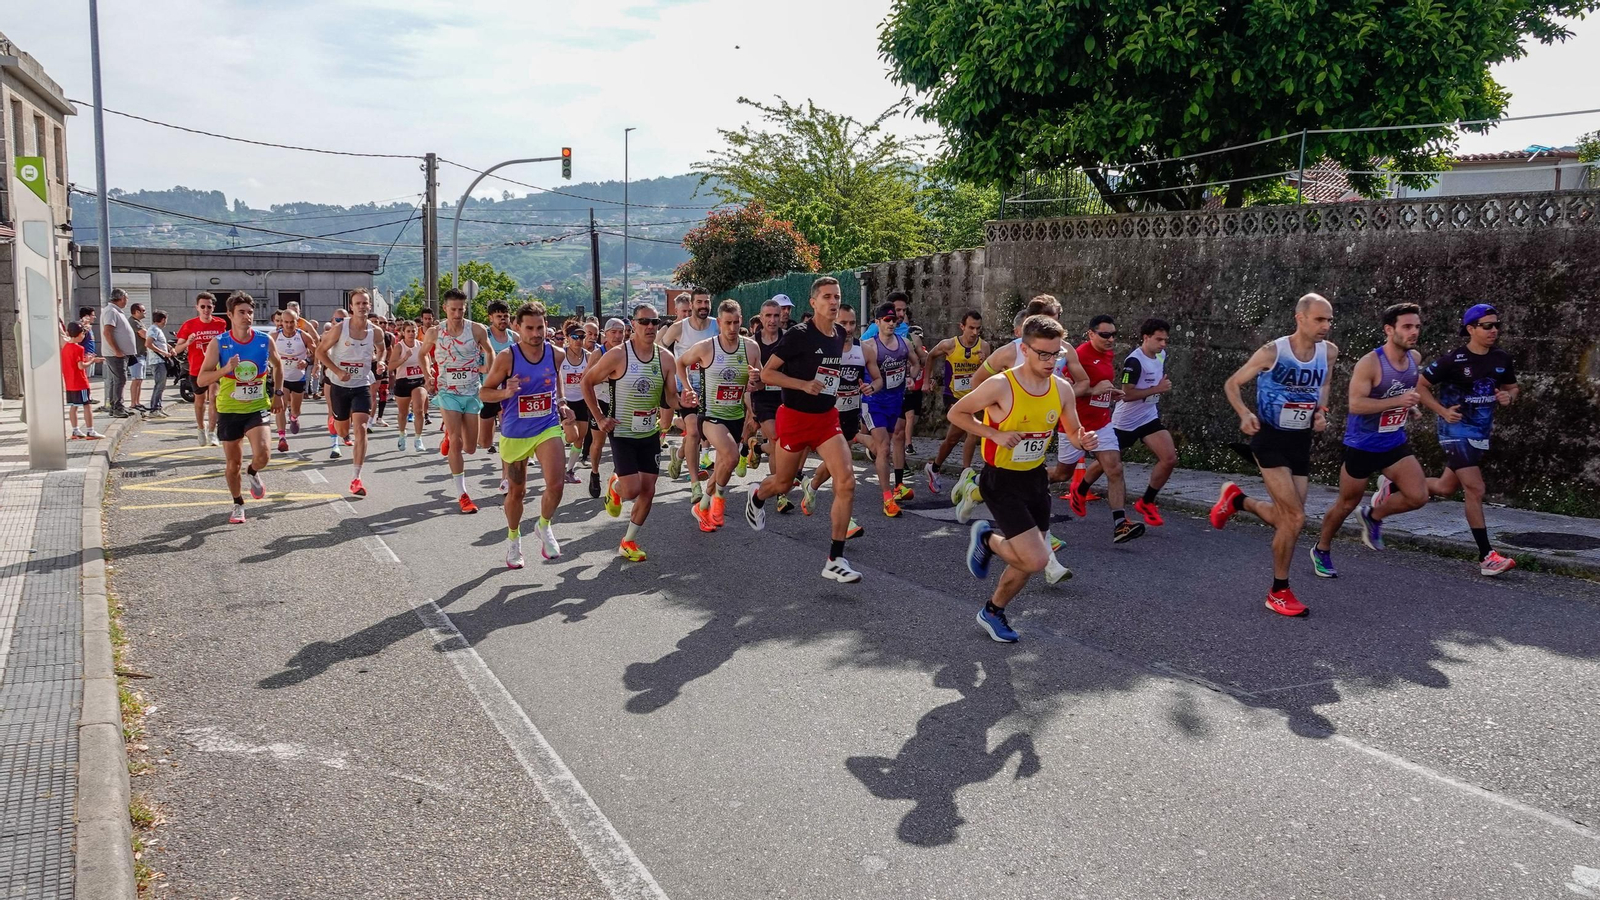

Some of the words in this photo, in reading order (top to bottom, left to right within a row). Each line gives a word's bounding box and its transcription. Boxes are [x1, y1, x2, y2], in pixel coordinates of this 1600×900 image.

[345, 366, 359, 374] 166
[452, 371, 467, 380] 205
[1284, 369, 1323, 387] ADN
[824, 377, 834, 387] 58
[241, 386, 257, 395] 132
[722, 391, 738, 400] 354
[526, 400, 545, 411] 361
[842, 397, 852, 405] 76
[1293, 410, 1306, 421] 75
[1023, 440, 1044, 452] 163
